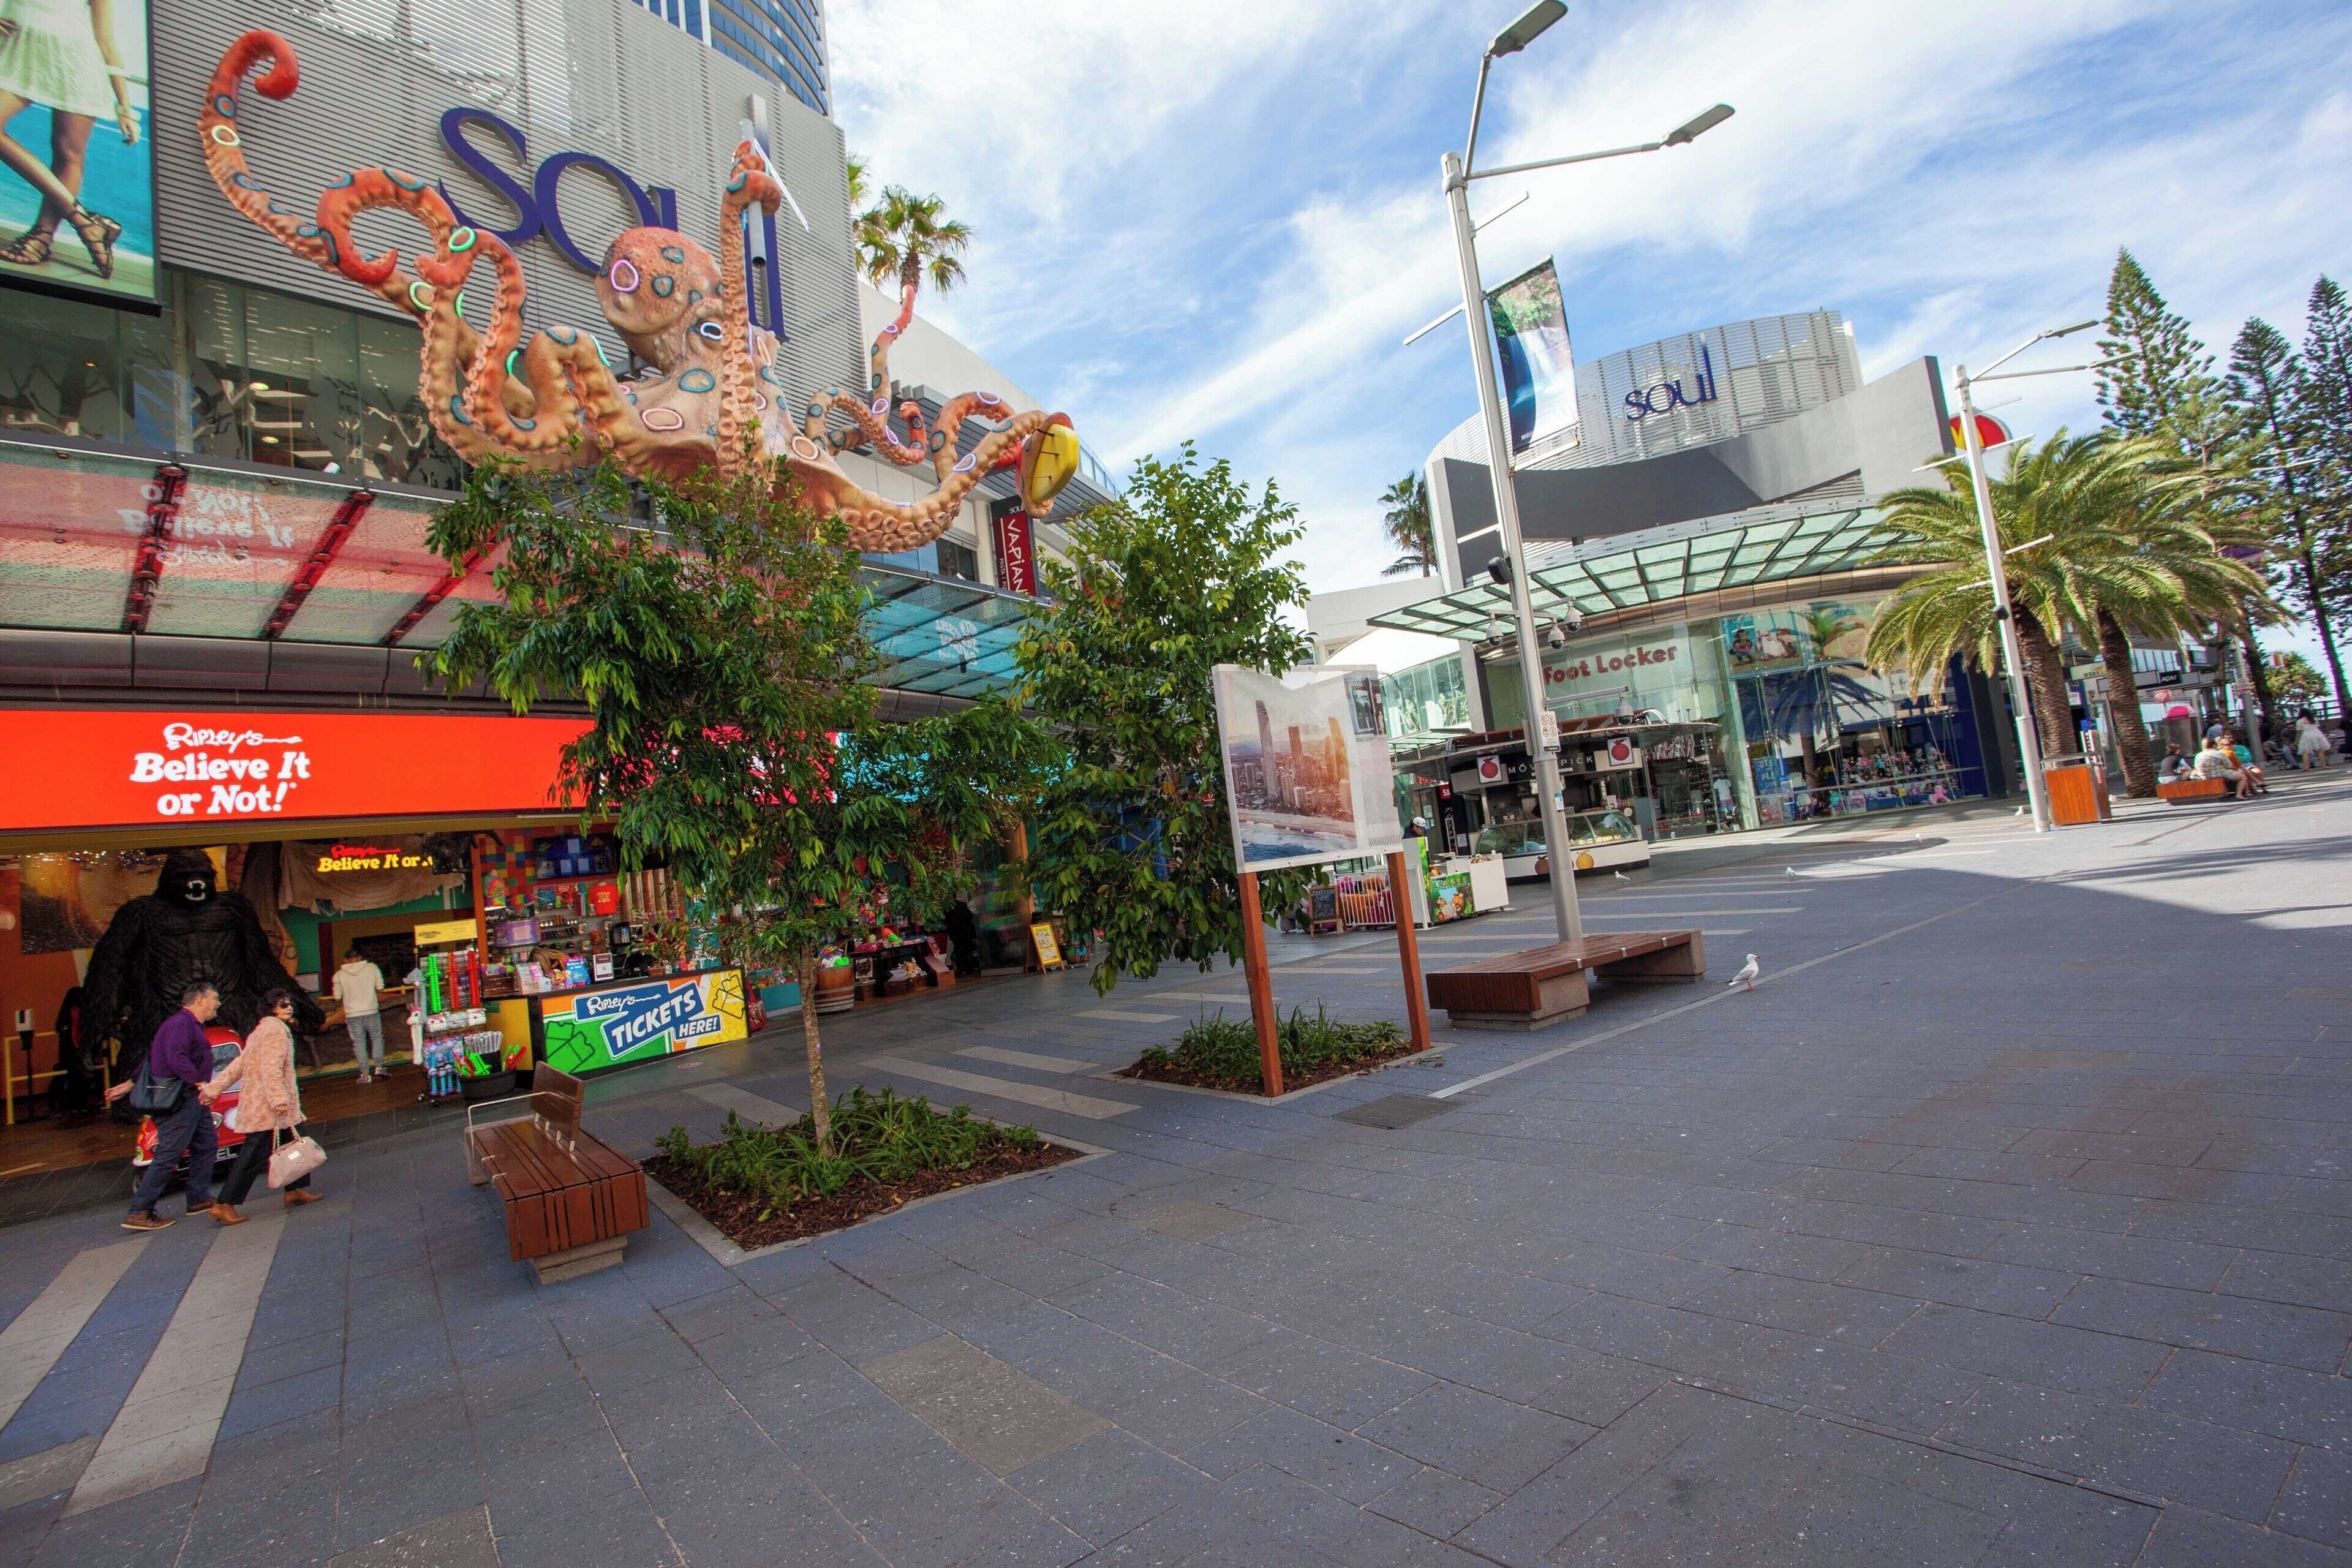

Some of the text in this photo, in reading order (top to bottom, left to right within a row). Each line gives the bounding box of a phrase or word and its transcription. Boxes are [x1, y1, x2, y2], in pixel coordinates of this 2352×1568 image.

[1625, 333, 1717, 420] soul
[1543, 646, 1677, 685] Foot Locker
[163, 722, 303, 754] Ripley's
[129, 751, 311, 783] Believe It
[157, 782, 288, 815] or Not!
[317, 856, 380, 872] Believe
[383, 854, 399, 869] It
[401, 856, 420, 867] or
[587, 994, 661, 1015] Ripley's
[612, 989, 695, 1048] TICKETS
[679, 1017, 718, 1037] HERE!
